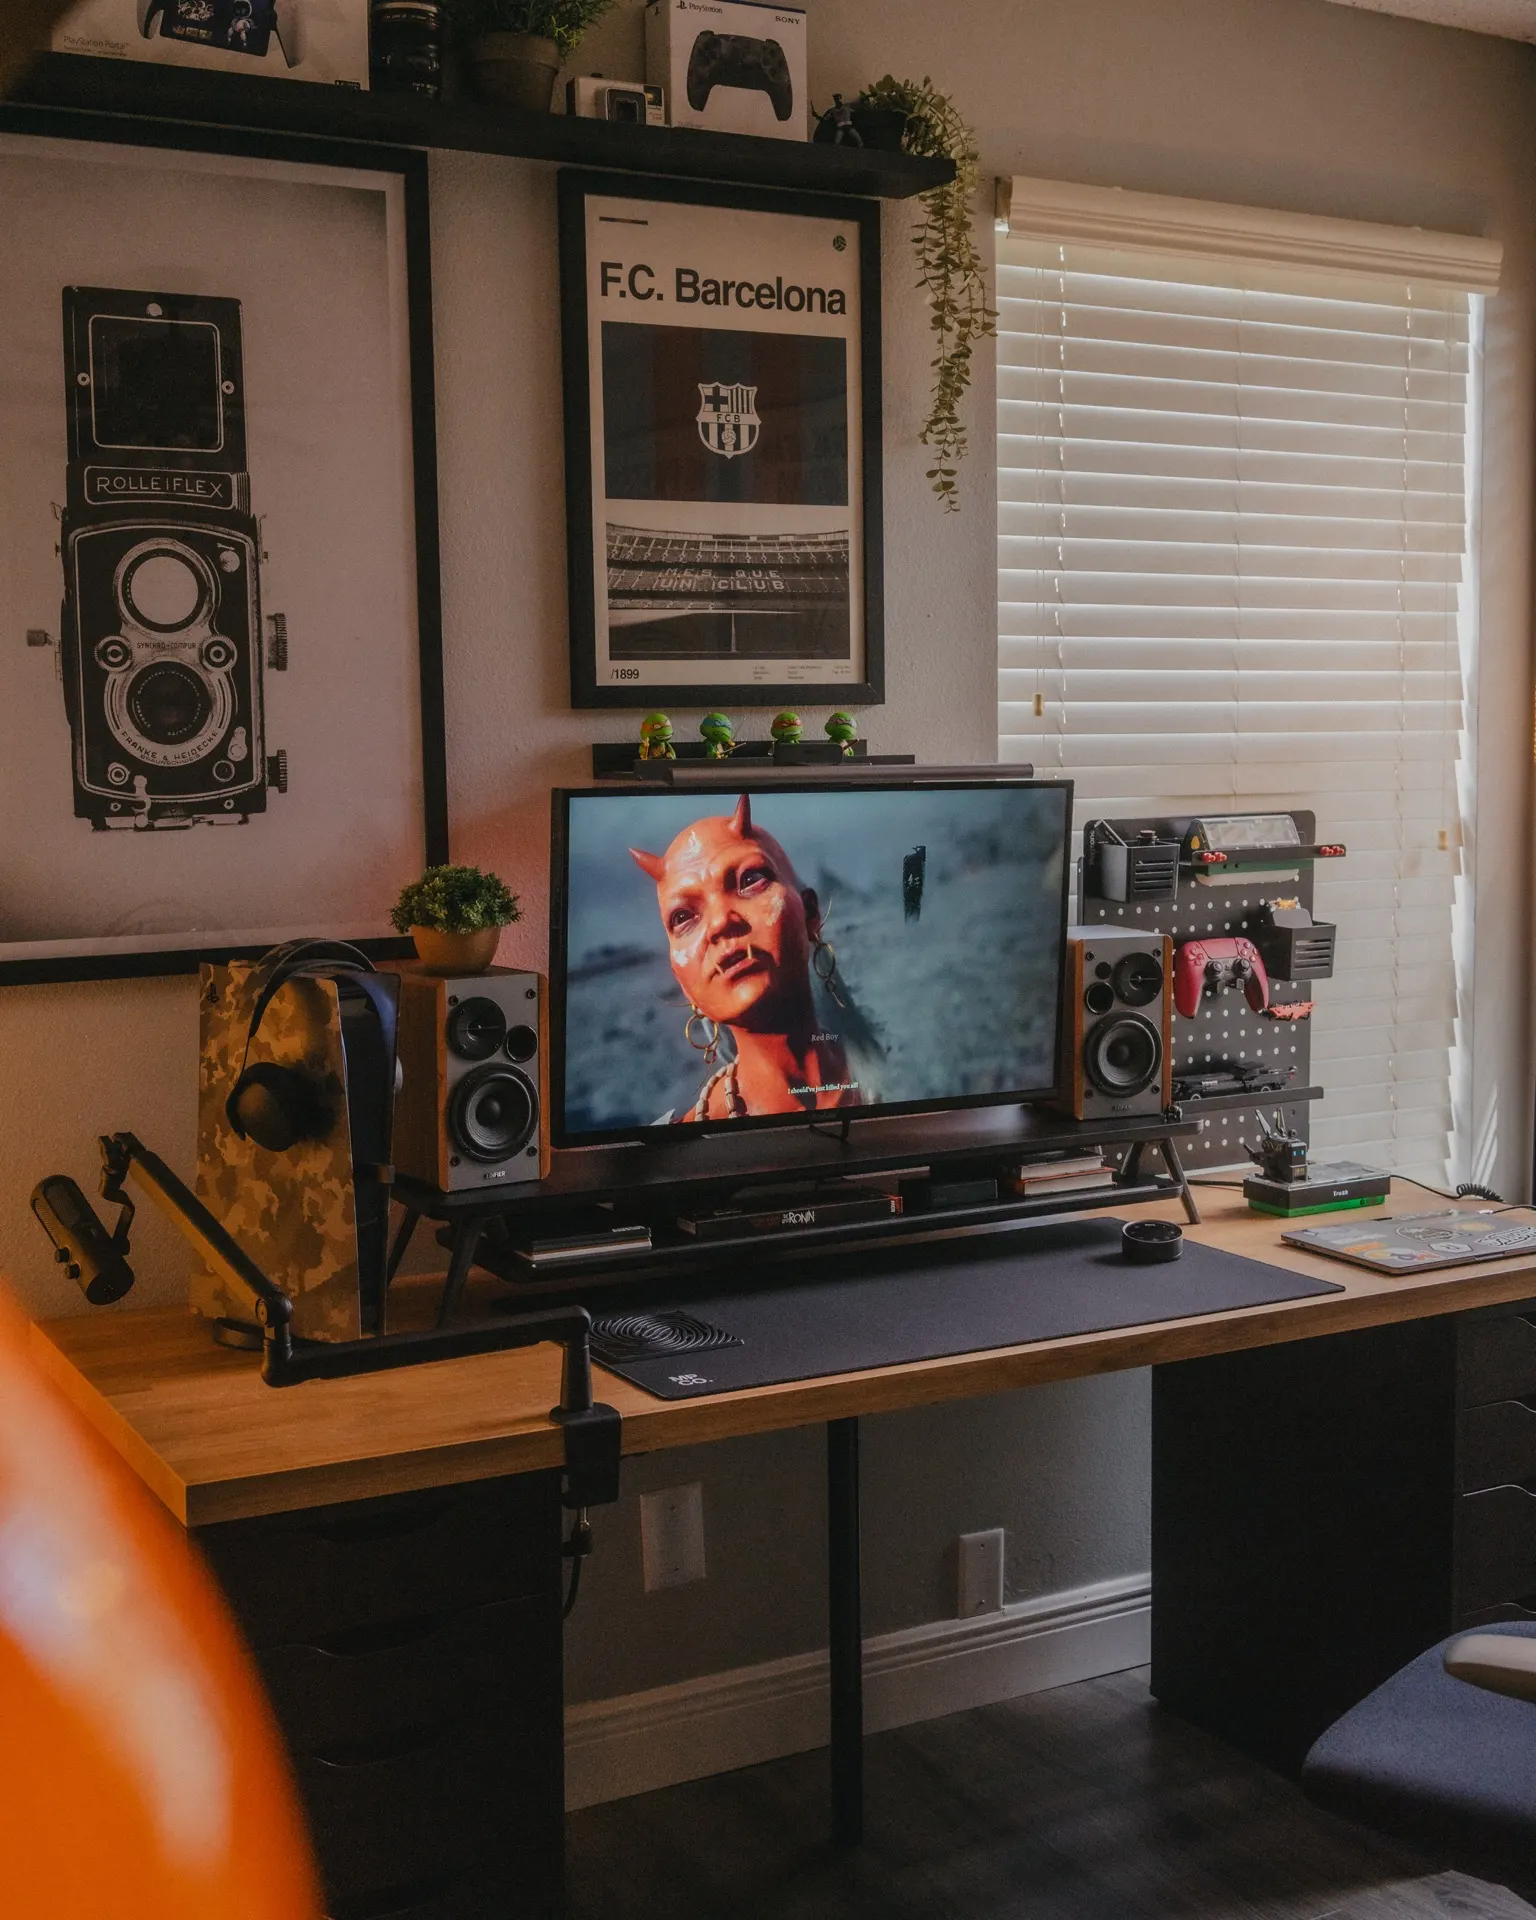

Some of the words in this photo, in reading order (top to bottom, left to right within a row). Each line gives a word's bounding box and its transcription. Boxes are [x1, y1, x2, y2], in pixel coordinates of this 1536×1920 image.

[689, 2, 723, 13] PlayStation
[775, 16, 800, 24] SONY
[600, 261, 664, 301] F.C.
[675, 267, 847, 315] Barcelona
[97, 476, 223, 498] ROLLEIFLEX
[735, 570, 780, 579] QUE
[660, 580, 694, 589] UN
[717, 580, 785, 590] CLUB
[121, 731, 157, 760] FRANKE
[173, 730, 218, 760] HEIDECKE
[811, 1034, 825, 1042] Red
[825, 1033, 839, 1042] Boy
[791, 1086, 815, 1094] should've
[815, 1084, 825, 1093] just
[826, 1083, 840, 1091] killed
[788, 1210, 815, 1225] RONIN
